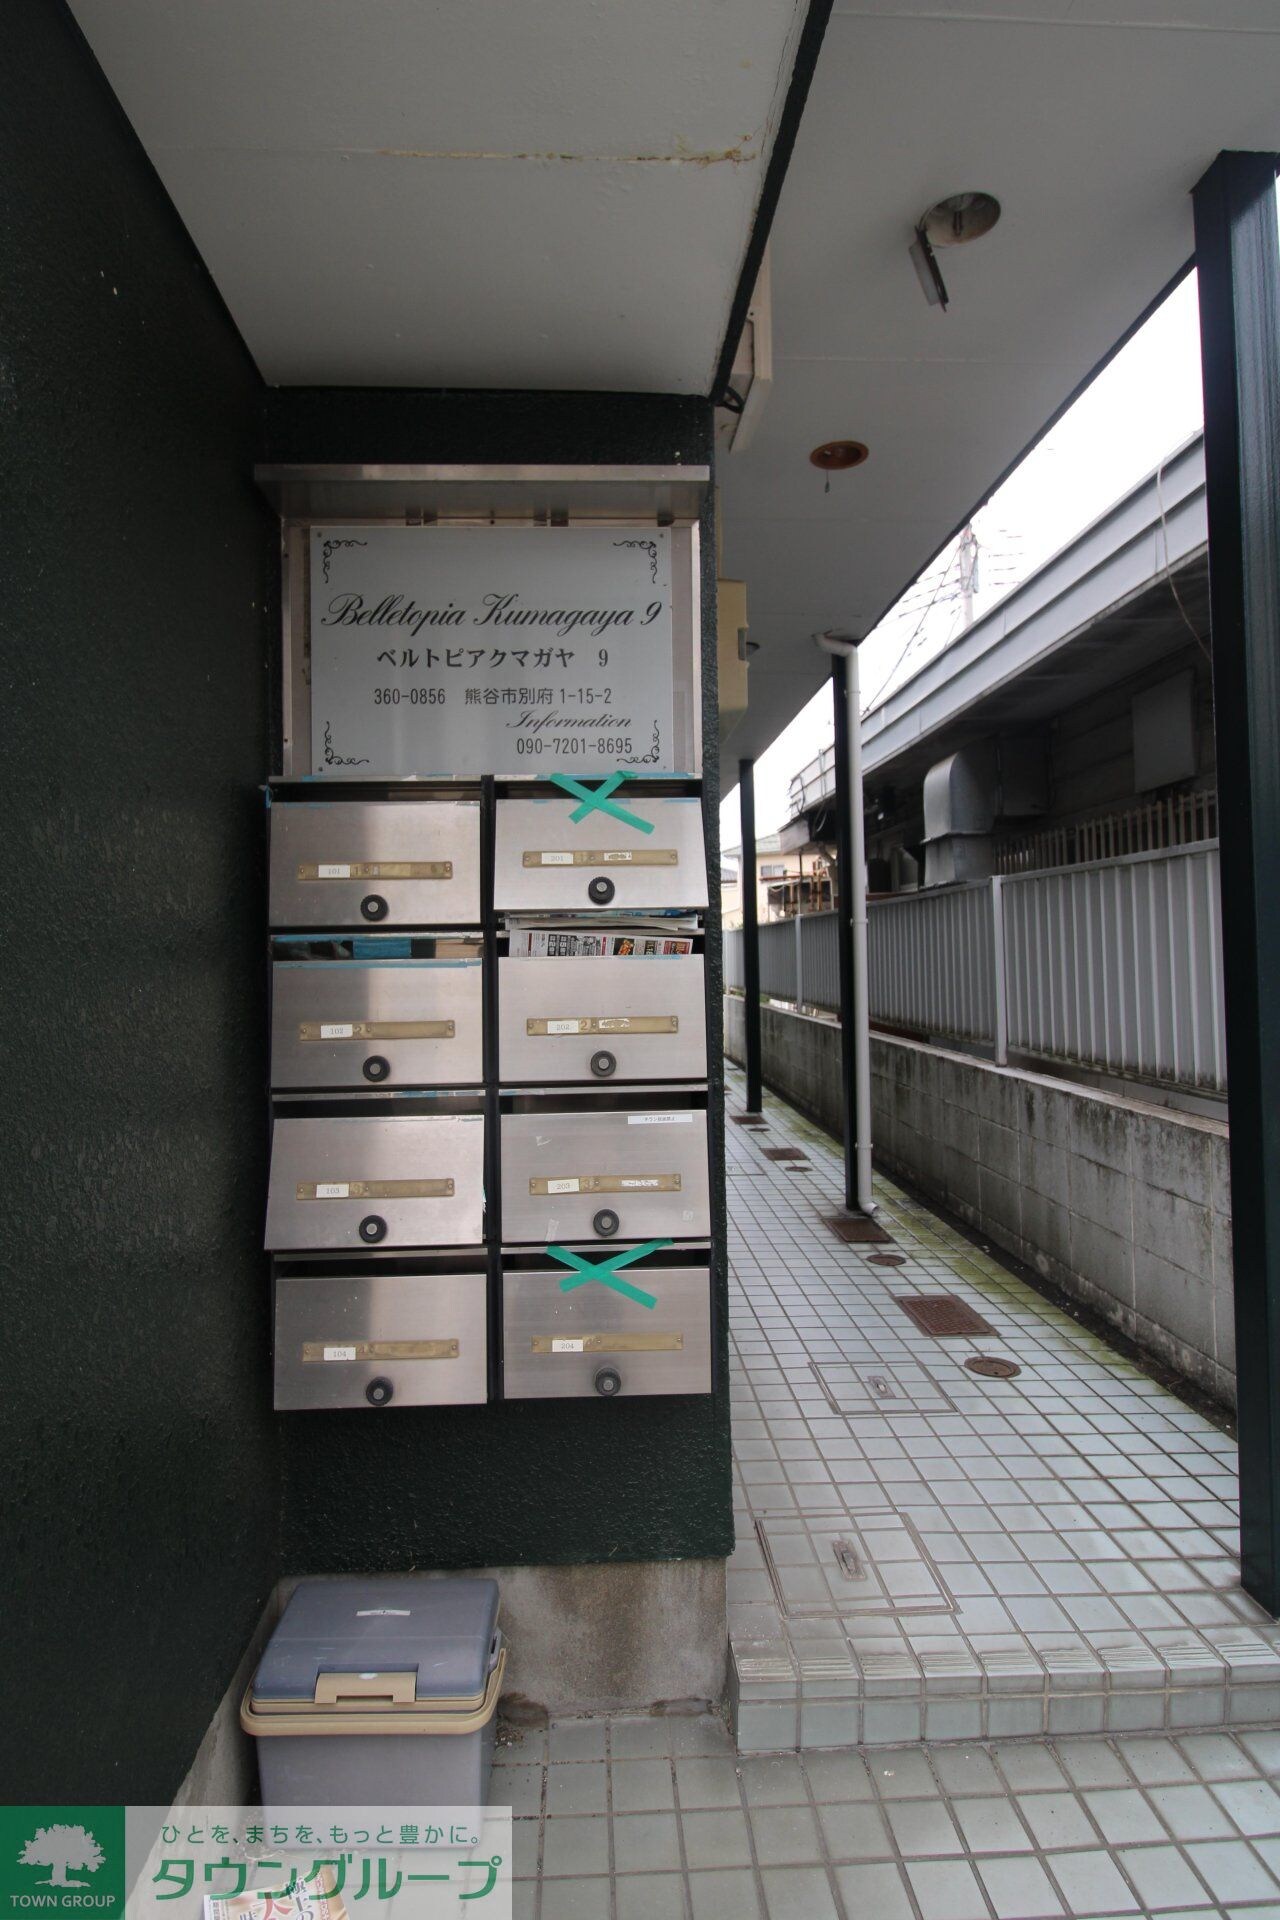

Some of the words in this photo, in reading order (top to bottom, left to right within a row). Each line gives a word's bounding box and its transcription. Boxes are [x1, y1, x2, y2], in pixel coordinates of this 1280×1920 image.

[321, 592, 466, 636] Belletopia
[473, 593, 634, 637] Kumagaya
[640, 601, 662, 626] 9
[377, 648, 576, 668] ベルトピアクマガヤ
[598, 648, 609, 668] 9
[374, 689, 446, 705] 360-0856
[505, 710, 632, 734] Information
[517, 738, 632, 755] 090-7201-8695
